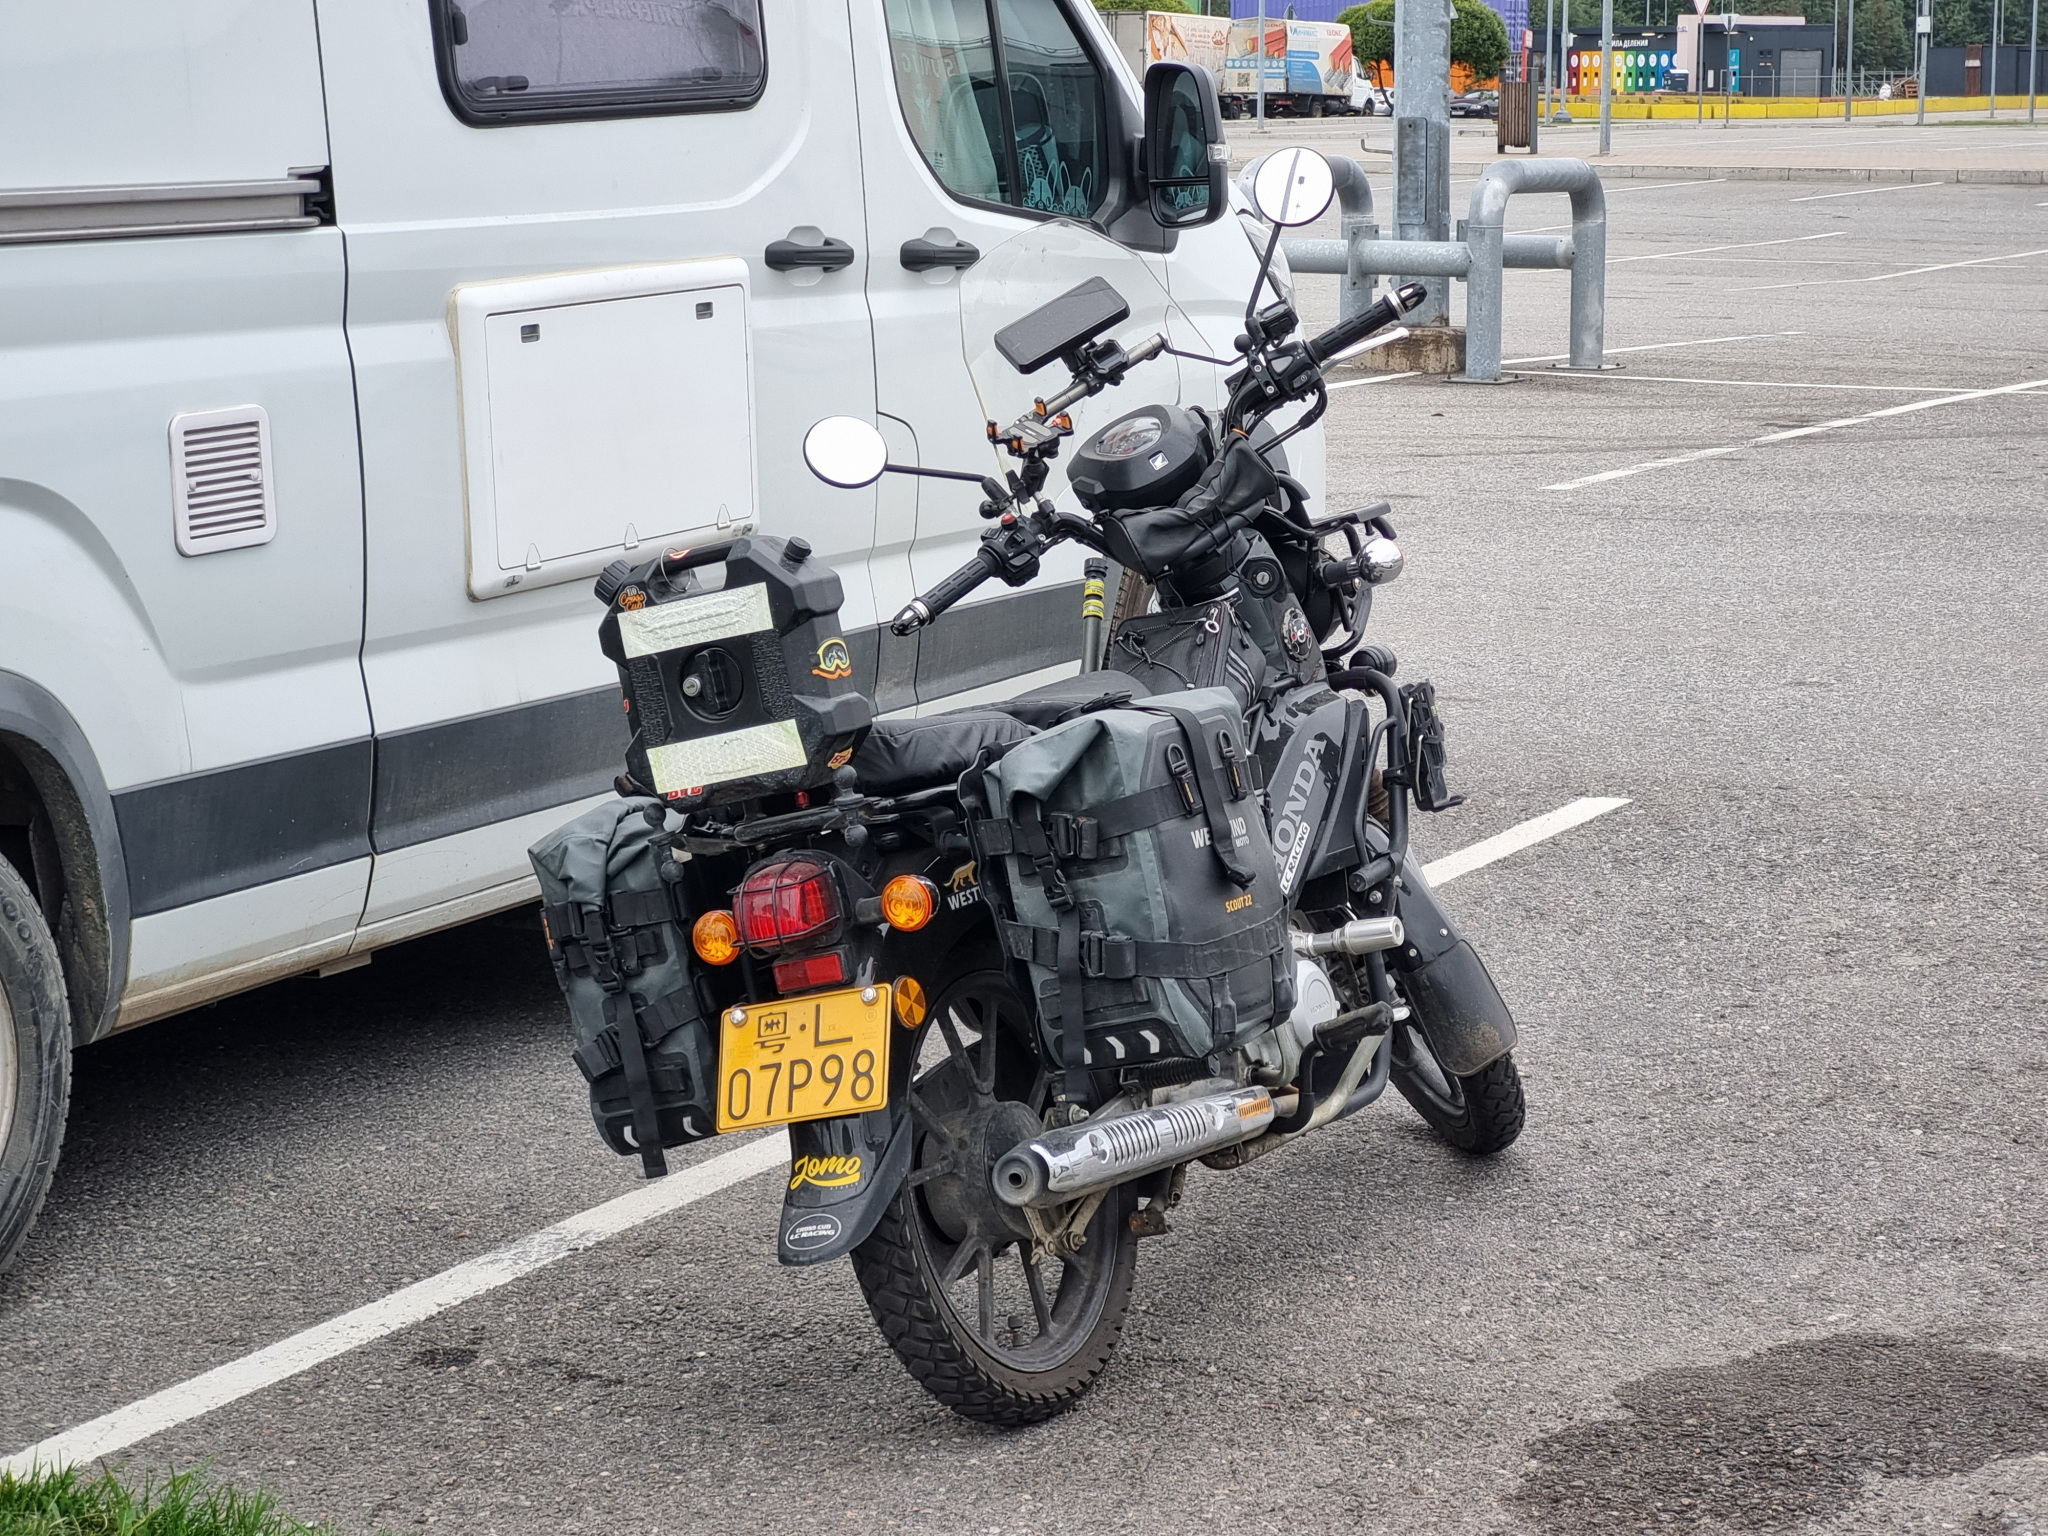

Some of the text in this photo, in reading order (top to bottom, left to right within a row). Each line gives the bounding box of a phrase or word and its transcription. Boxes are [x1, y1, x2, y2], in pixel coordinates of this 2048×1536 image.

[1598, 39, 1648, 48] ПИЛА ДЕЛЕНИЯ
[1235, 836, 1250, 848] MOTO
[1282, 825, 1310, 891] LC RACING
[947, 885, 983, 911] WEST
[1225, 893, 1253, 913] SCOUT 22
[728, 1049, 876, 1121] 07P98
[801, 1229, 836, 1238] RACING
